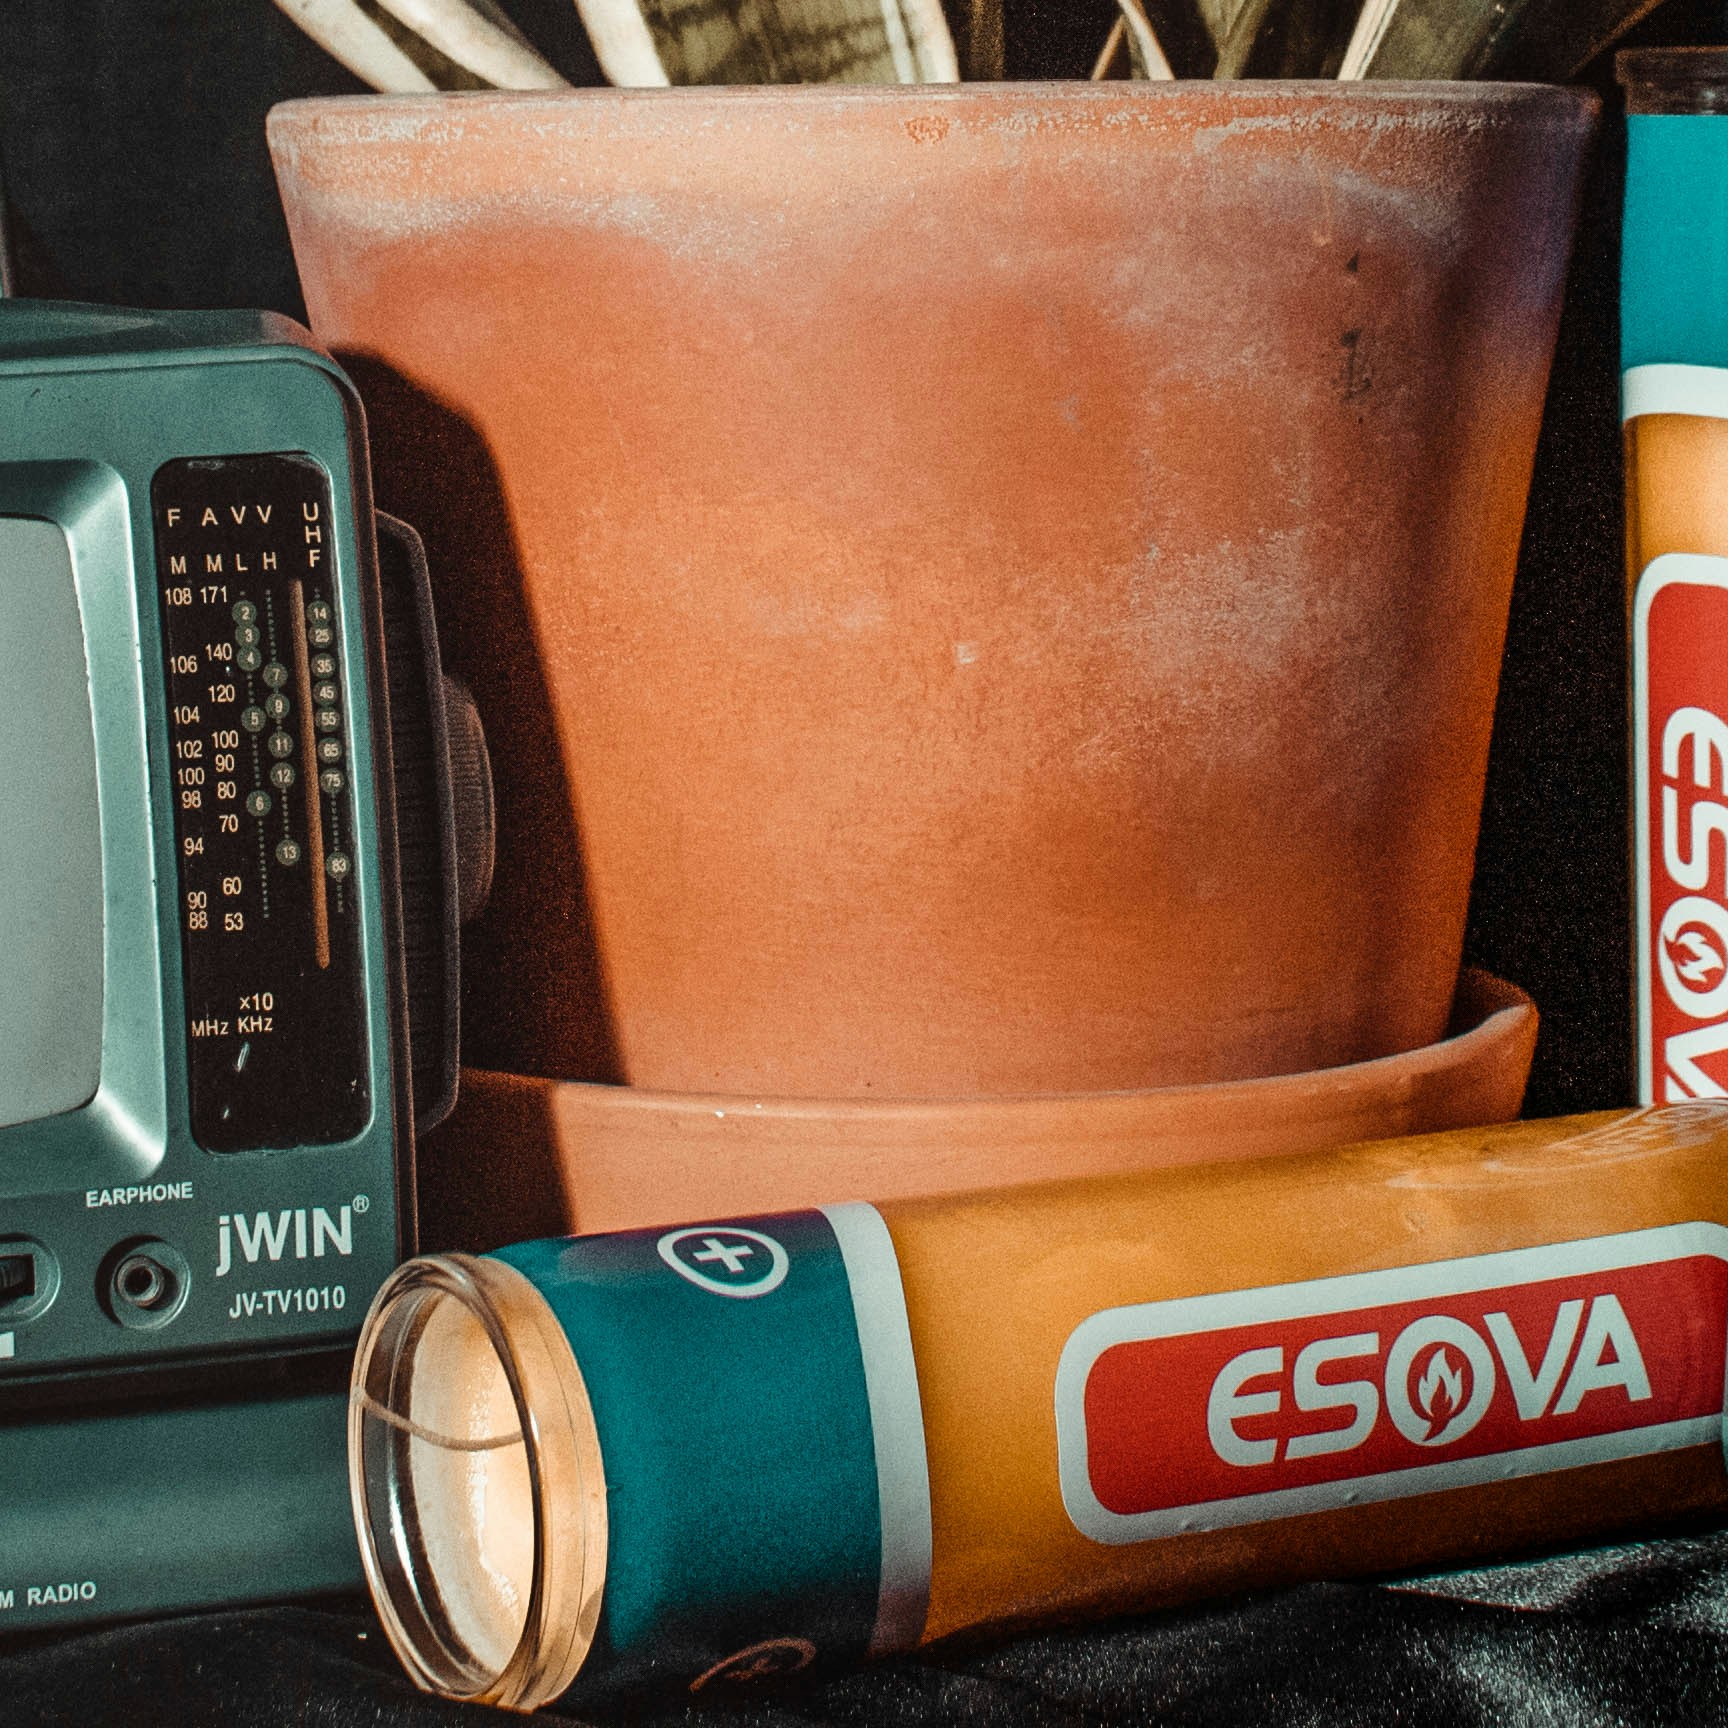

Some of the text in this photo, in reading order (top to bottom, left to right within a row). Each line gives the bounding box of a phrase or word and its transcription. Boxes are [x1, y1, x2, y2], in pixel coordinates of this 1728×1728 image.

[165, 587, 192, 605] 108
[200, 586, 227, 603] 171
[313, 608, 327, 620] 14
[315, 629, 330, 642] 25
[205, 643, 232, 661] 140
[170, 656, 197, 673] 106
[317, 659, 332, 672] 35
[208, 685, 235, 703] 120
[319, 686, 334, 699] 45
[174, 706, 200, 724] 104
[322, 711, 337, 724] 55
[212, 731, 239, 748] 100
[276, 739, 288, 751] 11
[176, 741, 202, 758] 102
[215, 754, 235, 772] 90
[178, 768, 205, 785] 100
[277, 769, 291, 783] 12
[327, 773, 341, 787] 75
[217, 782, 236, 799] 80
[181, 791, 201, 809] 98
[219, 814, 239, 832] 70
[184, 837, 204, 855] 94
[283, 845, 297, 858] 13
[223, 877, 242, 895] 60
[188, 891, 207, 909] 90
[224, 912, 244, 931] 53
[192, 1016, 273, 1037] MHz KHz
[85, 1181, 194, 1208] EARPHONE
[228, 1285, 346, 1319] JV-TV1010
[1207, 1294, 1652, 1468] ESOVA
[26, 1580, 97, 1606] RADIO
